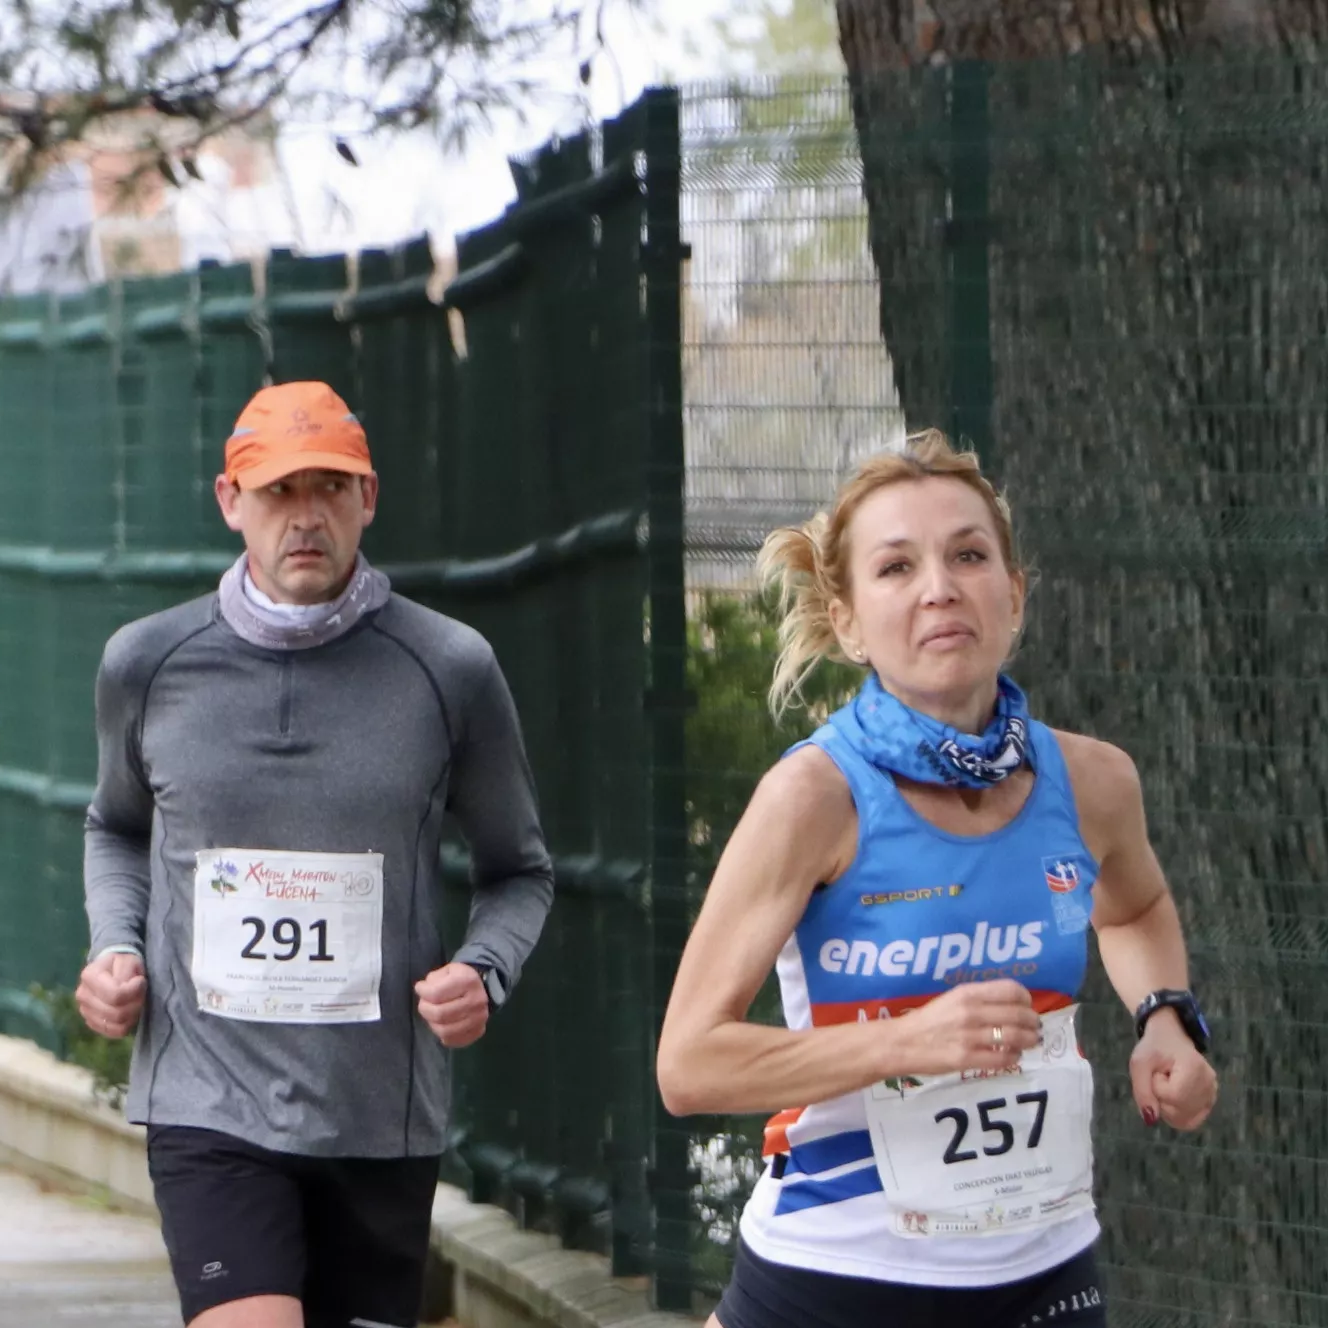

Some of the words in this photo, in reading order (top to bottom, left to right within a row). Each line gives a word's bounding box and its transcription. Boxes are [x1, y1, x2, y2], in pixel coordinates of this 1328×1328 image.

[265, 880, 323, 901] LUCENA
[240, 916, 335, 962] 291
[819, 920, 1043, 981] enerplus
[934, 1089, 1049, 1165] 257
